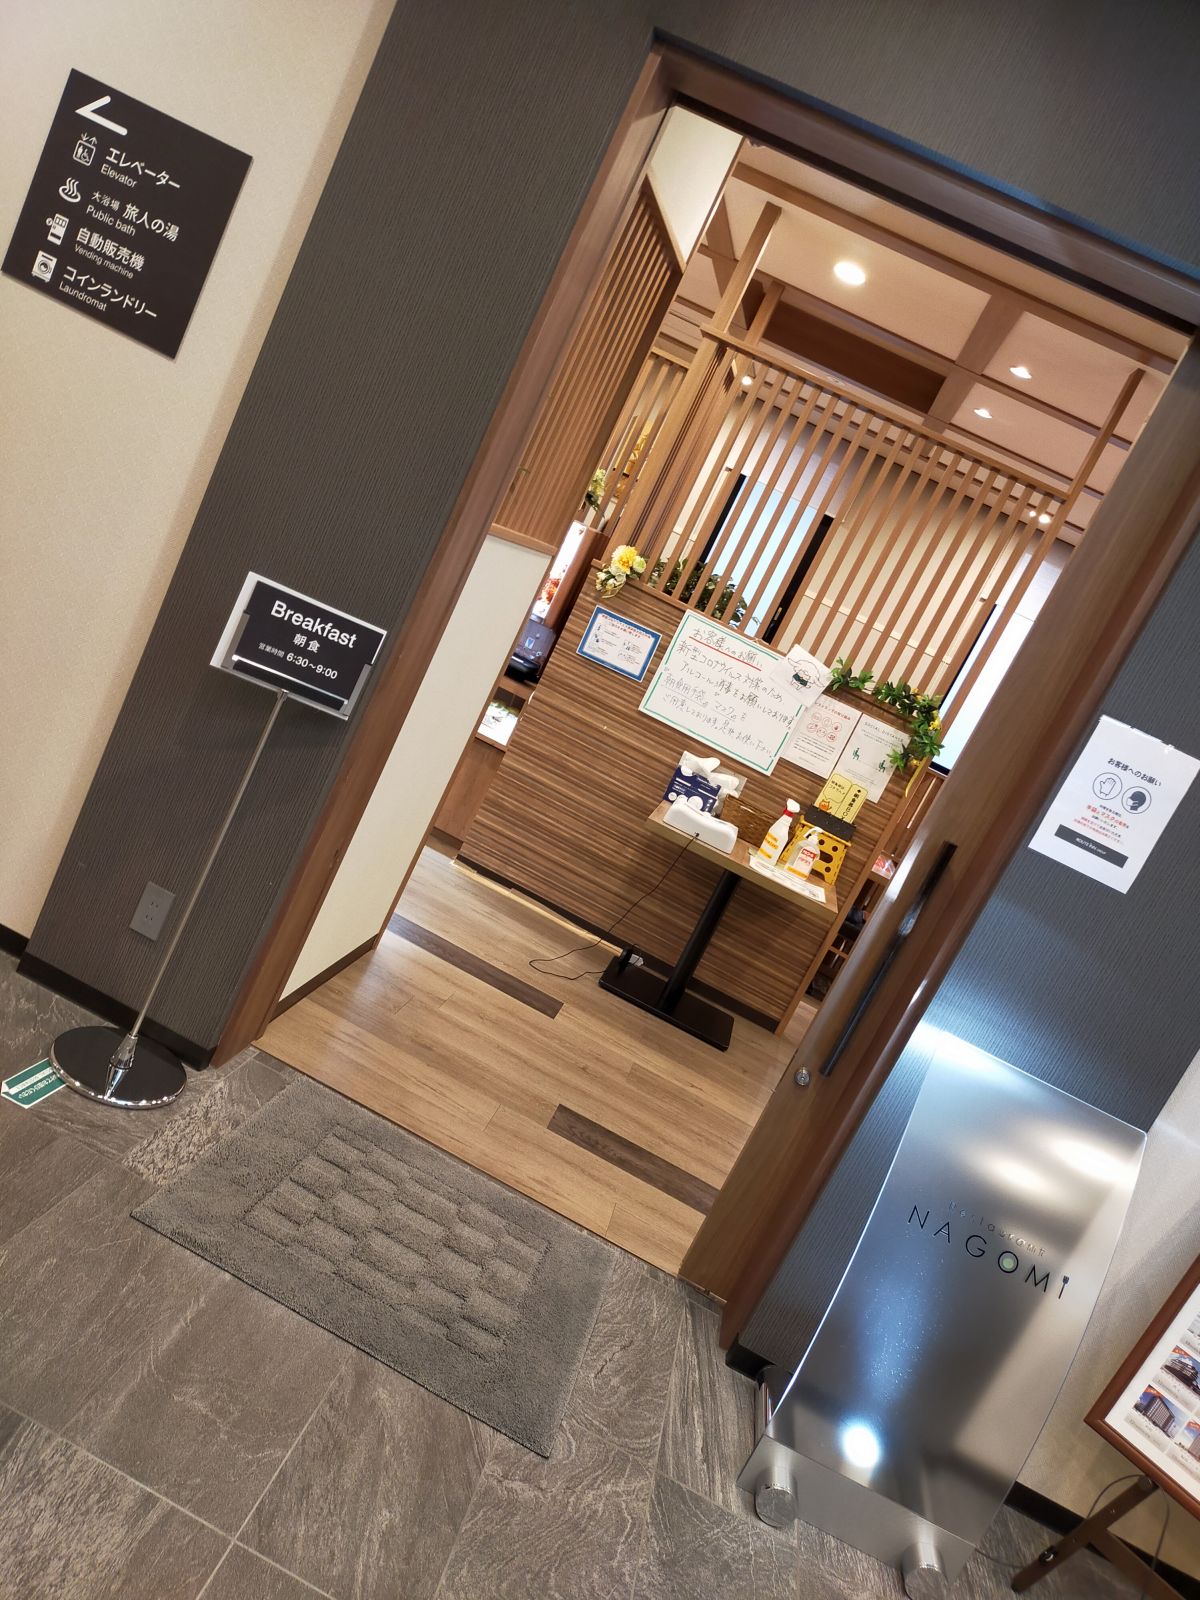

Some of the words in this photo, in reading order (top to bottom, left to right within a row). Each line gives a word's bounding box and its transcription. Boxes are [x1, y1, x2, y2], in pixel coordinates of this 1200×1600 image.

[101, 165, 137, 188] Elevator
[106, 148, 180, 188] エレベーター
[86, 205, 114, 226] Public
[115, 218, 136, 236] bath
[92, 191, 119, 211] 大浴場
[123, 202, 179, 242] 旅人の湯
[75, 245, 102, 266] Vending
[103, 258, 134, 279] machine
[77, 228, 144, 271] 自動販売機
[59, 281, 107, 312] Laundromat
[63, 266, 157, 318] コインランドリー
[271, 600, 357, 648] Breakfast
[293, 633, 320, 653] 朝食
[1108, 758, 1162, 787] お客様へのお願い
